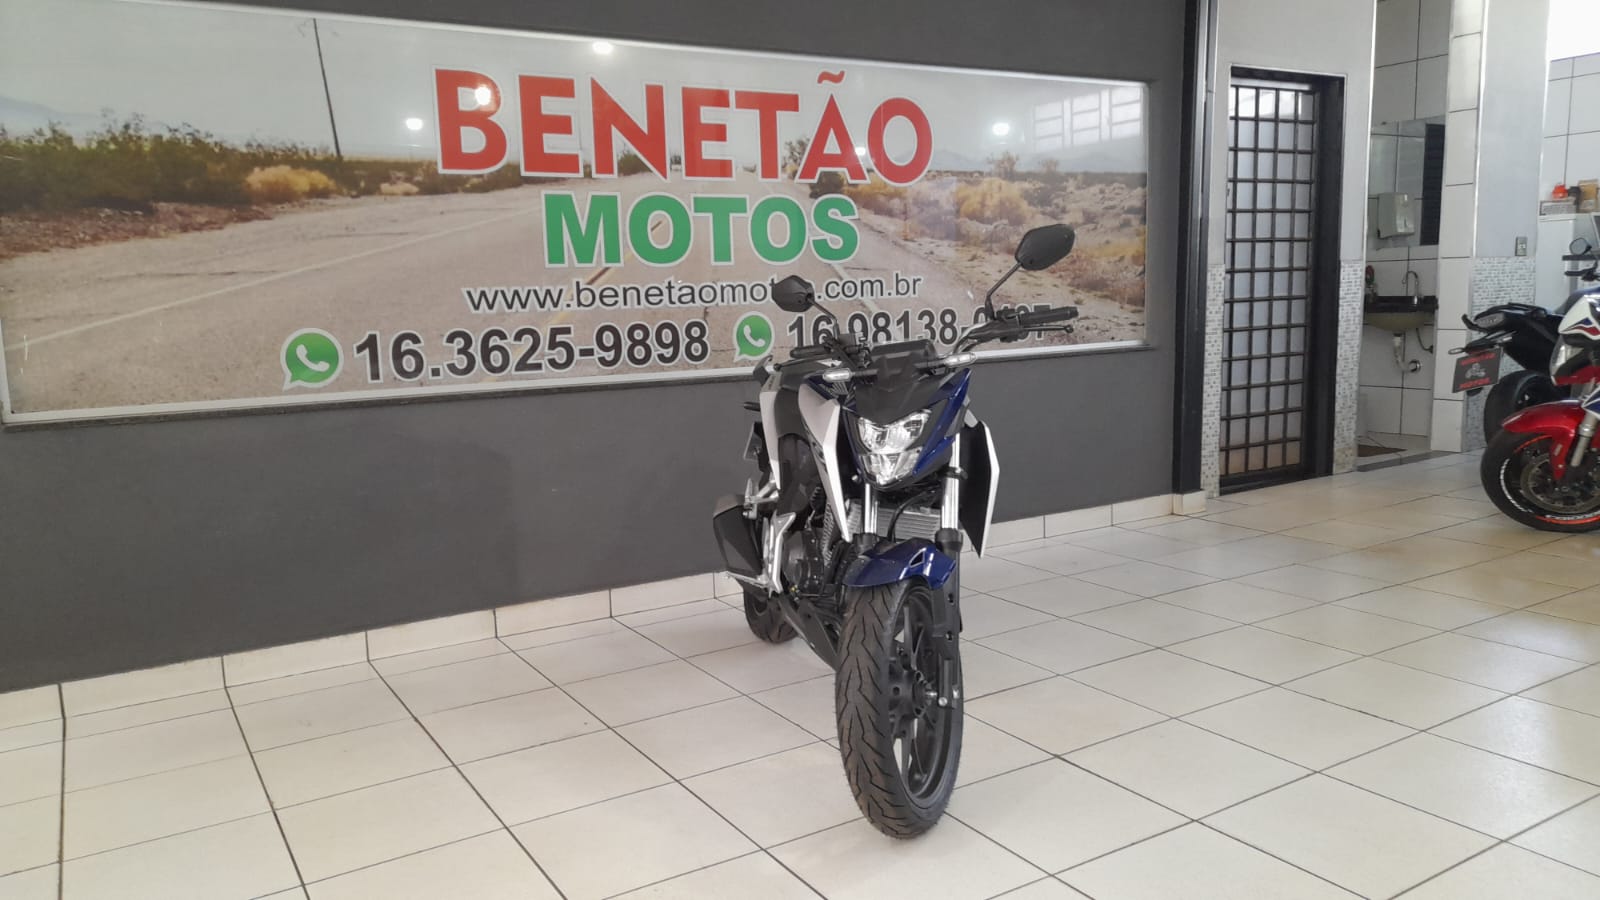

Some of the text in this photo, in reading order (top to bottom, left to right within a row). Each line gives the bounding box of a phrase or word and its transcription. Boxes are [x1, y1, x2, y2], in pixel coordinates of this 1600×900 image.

[434, 68, 934, 184] BENETÃO
[543, 193, 860, 268] MOTOS
[355, 322, 708, 382] 16.3625-9898
